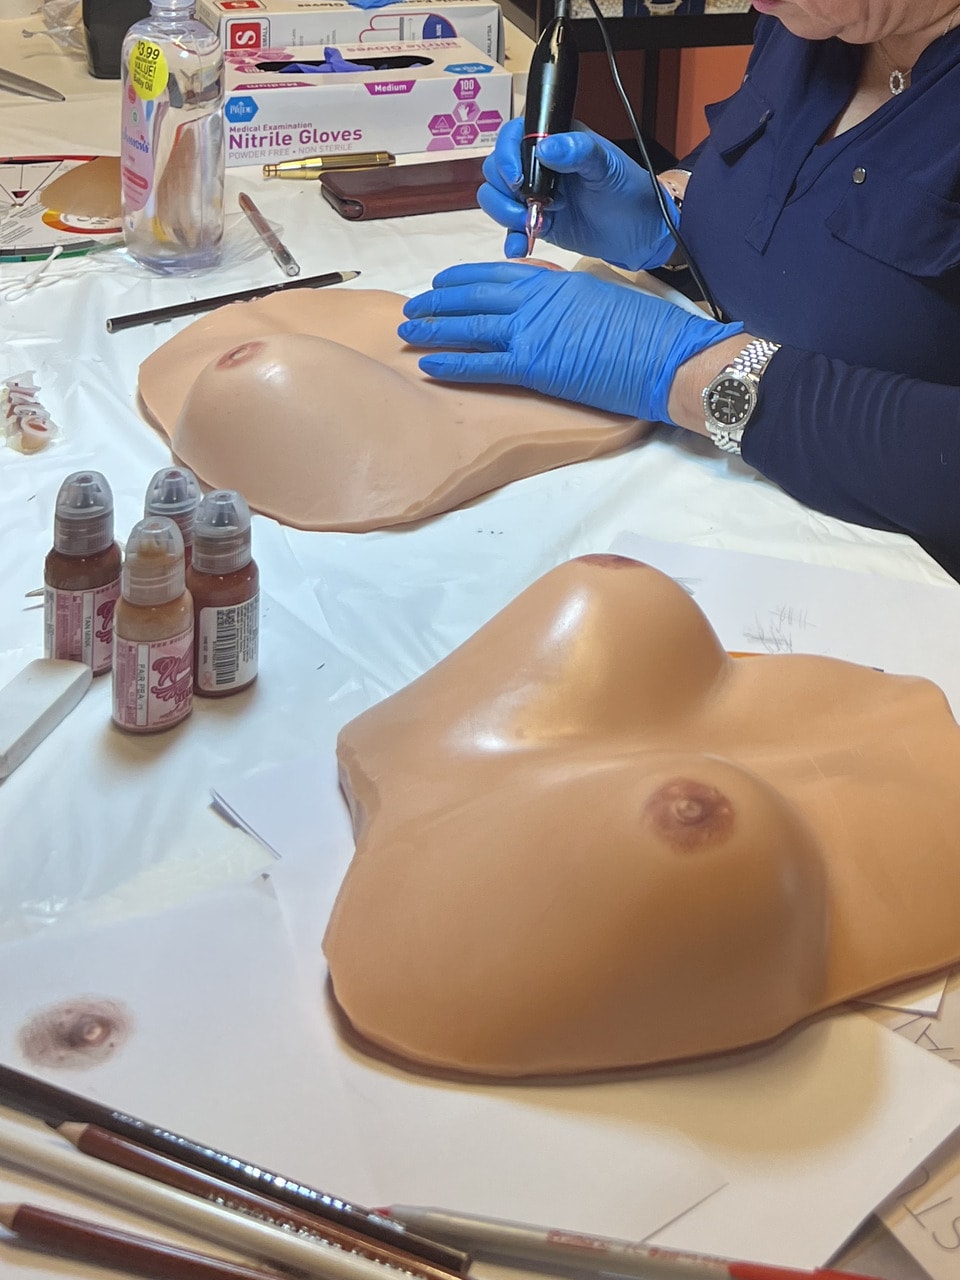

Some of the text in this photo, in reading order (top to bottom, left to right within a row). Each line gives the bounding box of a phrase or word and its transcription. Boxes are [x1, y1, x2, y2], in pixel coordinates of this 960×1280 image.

[235, 30, 256, 45] S
[374, 83, 407, 92] Medium
[460, 80, 474, 90] 100
[229, 122, 312, 133] Medical Examination
[229, 129, 363, 150] Nitrile Gloves
[229, 143, 353, 159] POWDER FREE NON STERILE
[138, 664, 146, 681] FAIR
